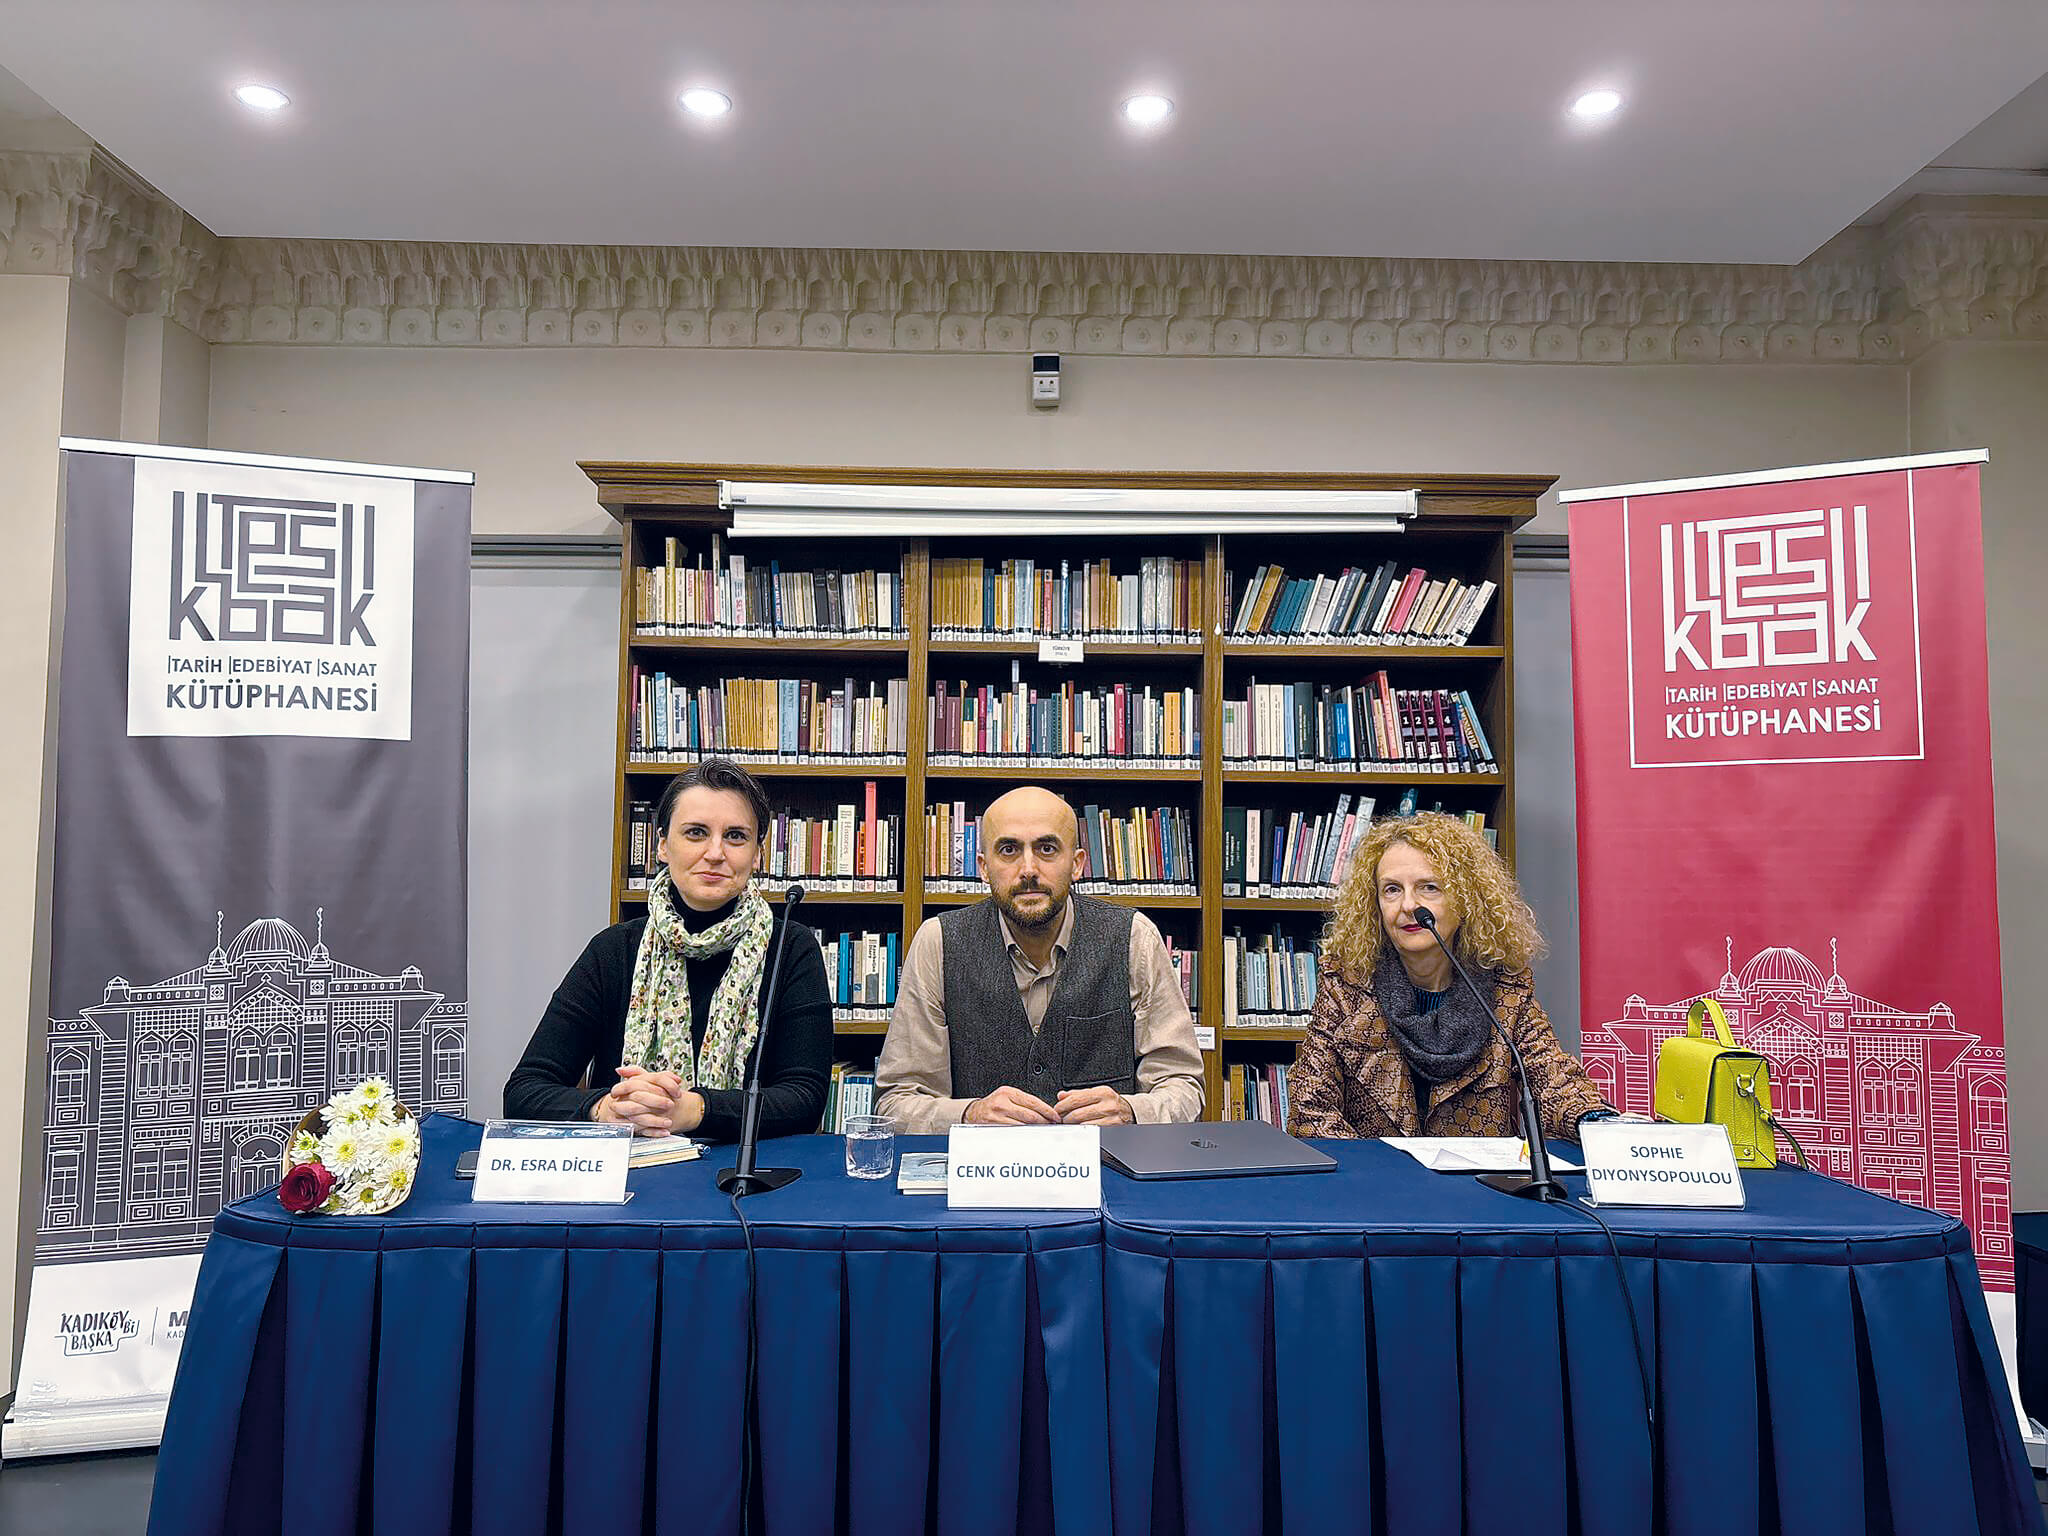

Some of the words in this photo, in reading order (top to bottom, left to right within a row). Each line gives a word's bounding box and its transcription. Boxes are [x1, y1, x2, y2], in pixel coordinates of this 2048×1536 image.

[166, 679, 378, 712] KÜTÜPHANESİ
[1665, 699, 1882, 740] KÜTÜPHANESİ
[1630, 1146, 1684, 1159] SOPHIE
[491, 1159, 516, 1172] DR.
[521, 1159, 557, 1172] ESRA
[563, 1157, 603, 1172] DİCLE
[956, 1165, 995, 1178] CENK
[1000, 1162, 1090, 1178] GÜNDOĞDU
[1592, 1168, 1732, 1184] DIYONYSOPOULOU
[60, 1310, 129, 1333] KADIKÖY
[71, 1331, 113, 1351] BAŞKA
